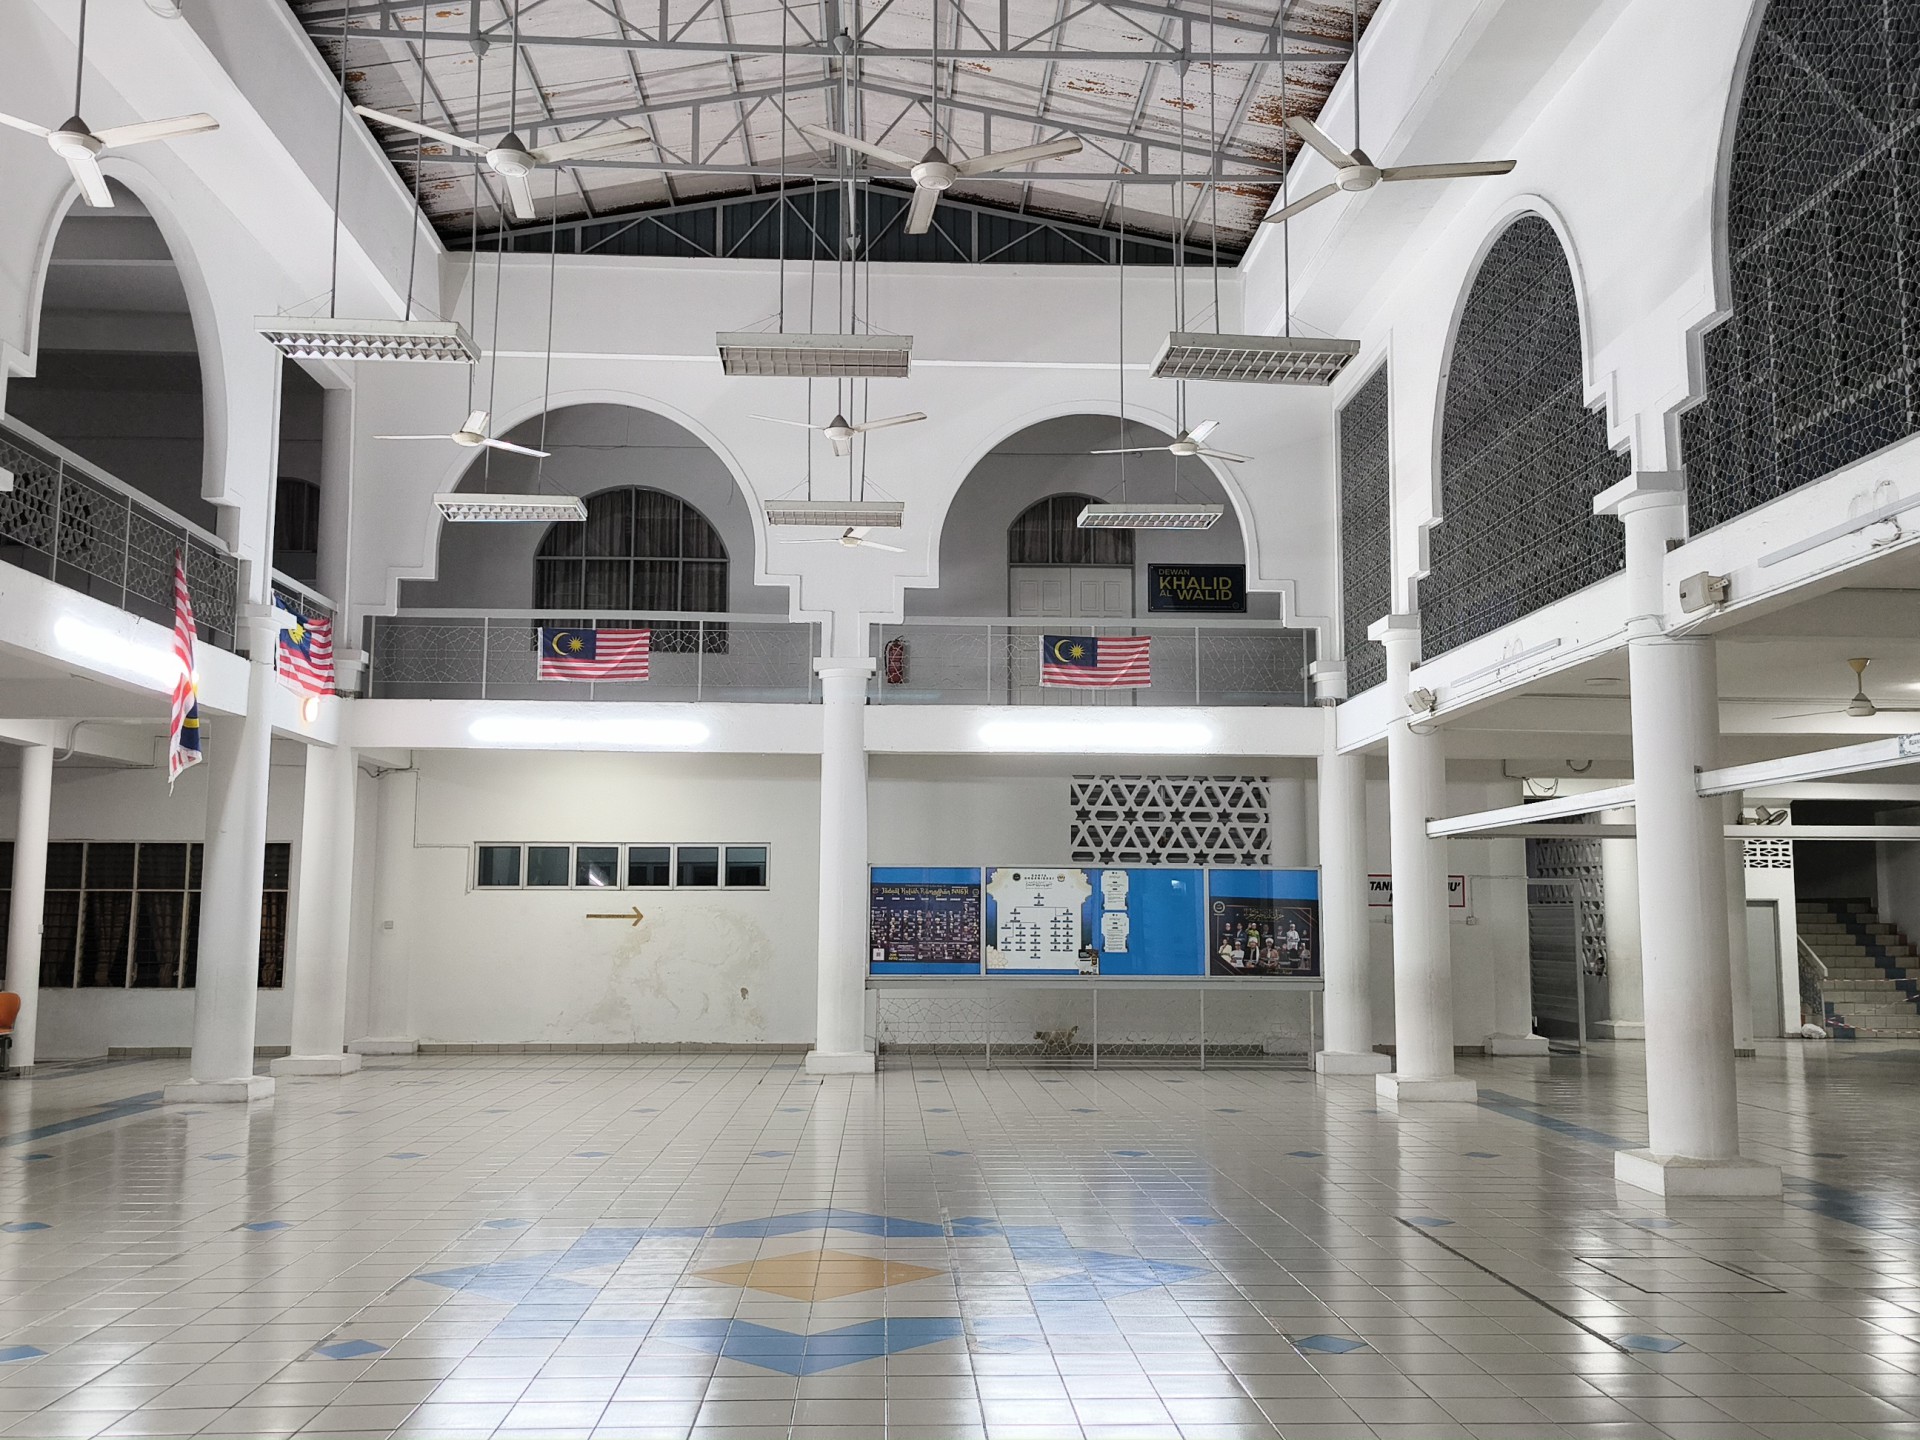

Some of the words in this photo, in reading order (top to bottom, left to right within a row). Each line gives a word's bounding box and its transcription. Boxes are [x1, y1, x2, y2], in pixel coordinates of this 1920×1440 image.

[1159, 576, 1232, 589] KHALID
[1159, 589, 1173, 597] AL
[1177, 589, 1232, 600] WALID
